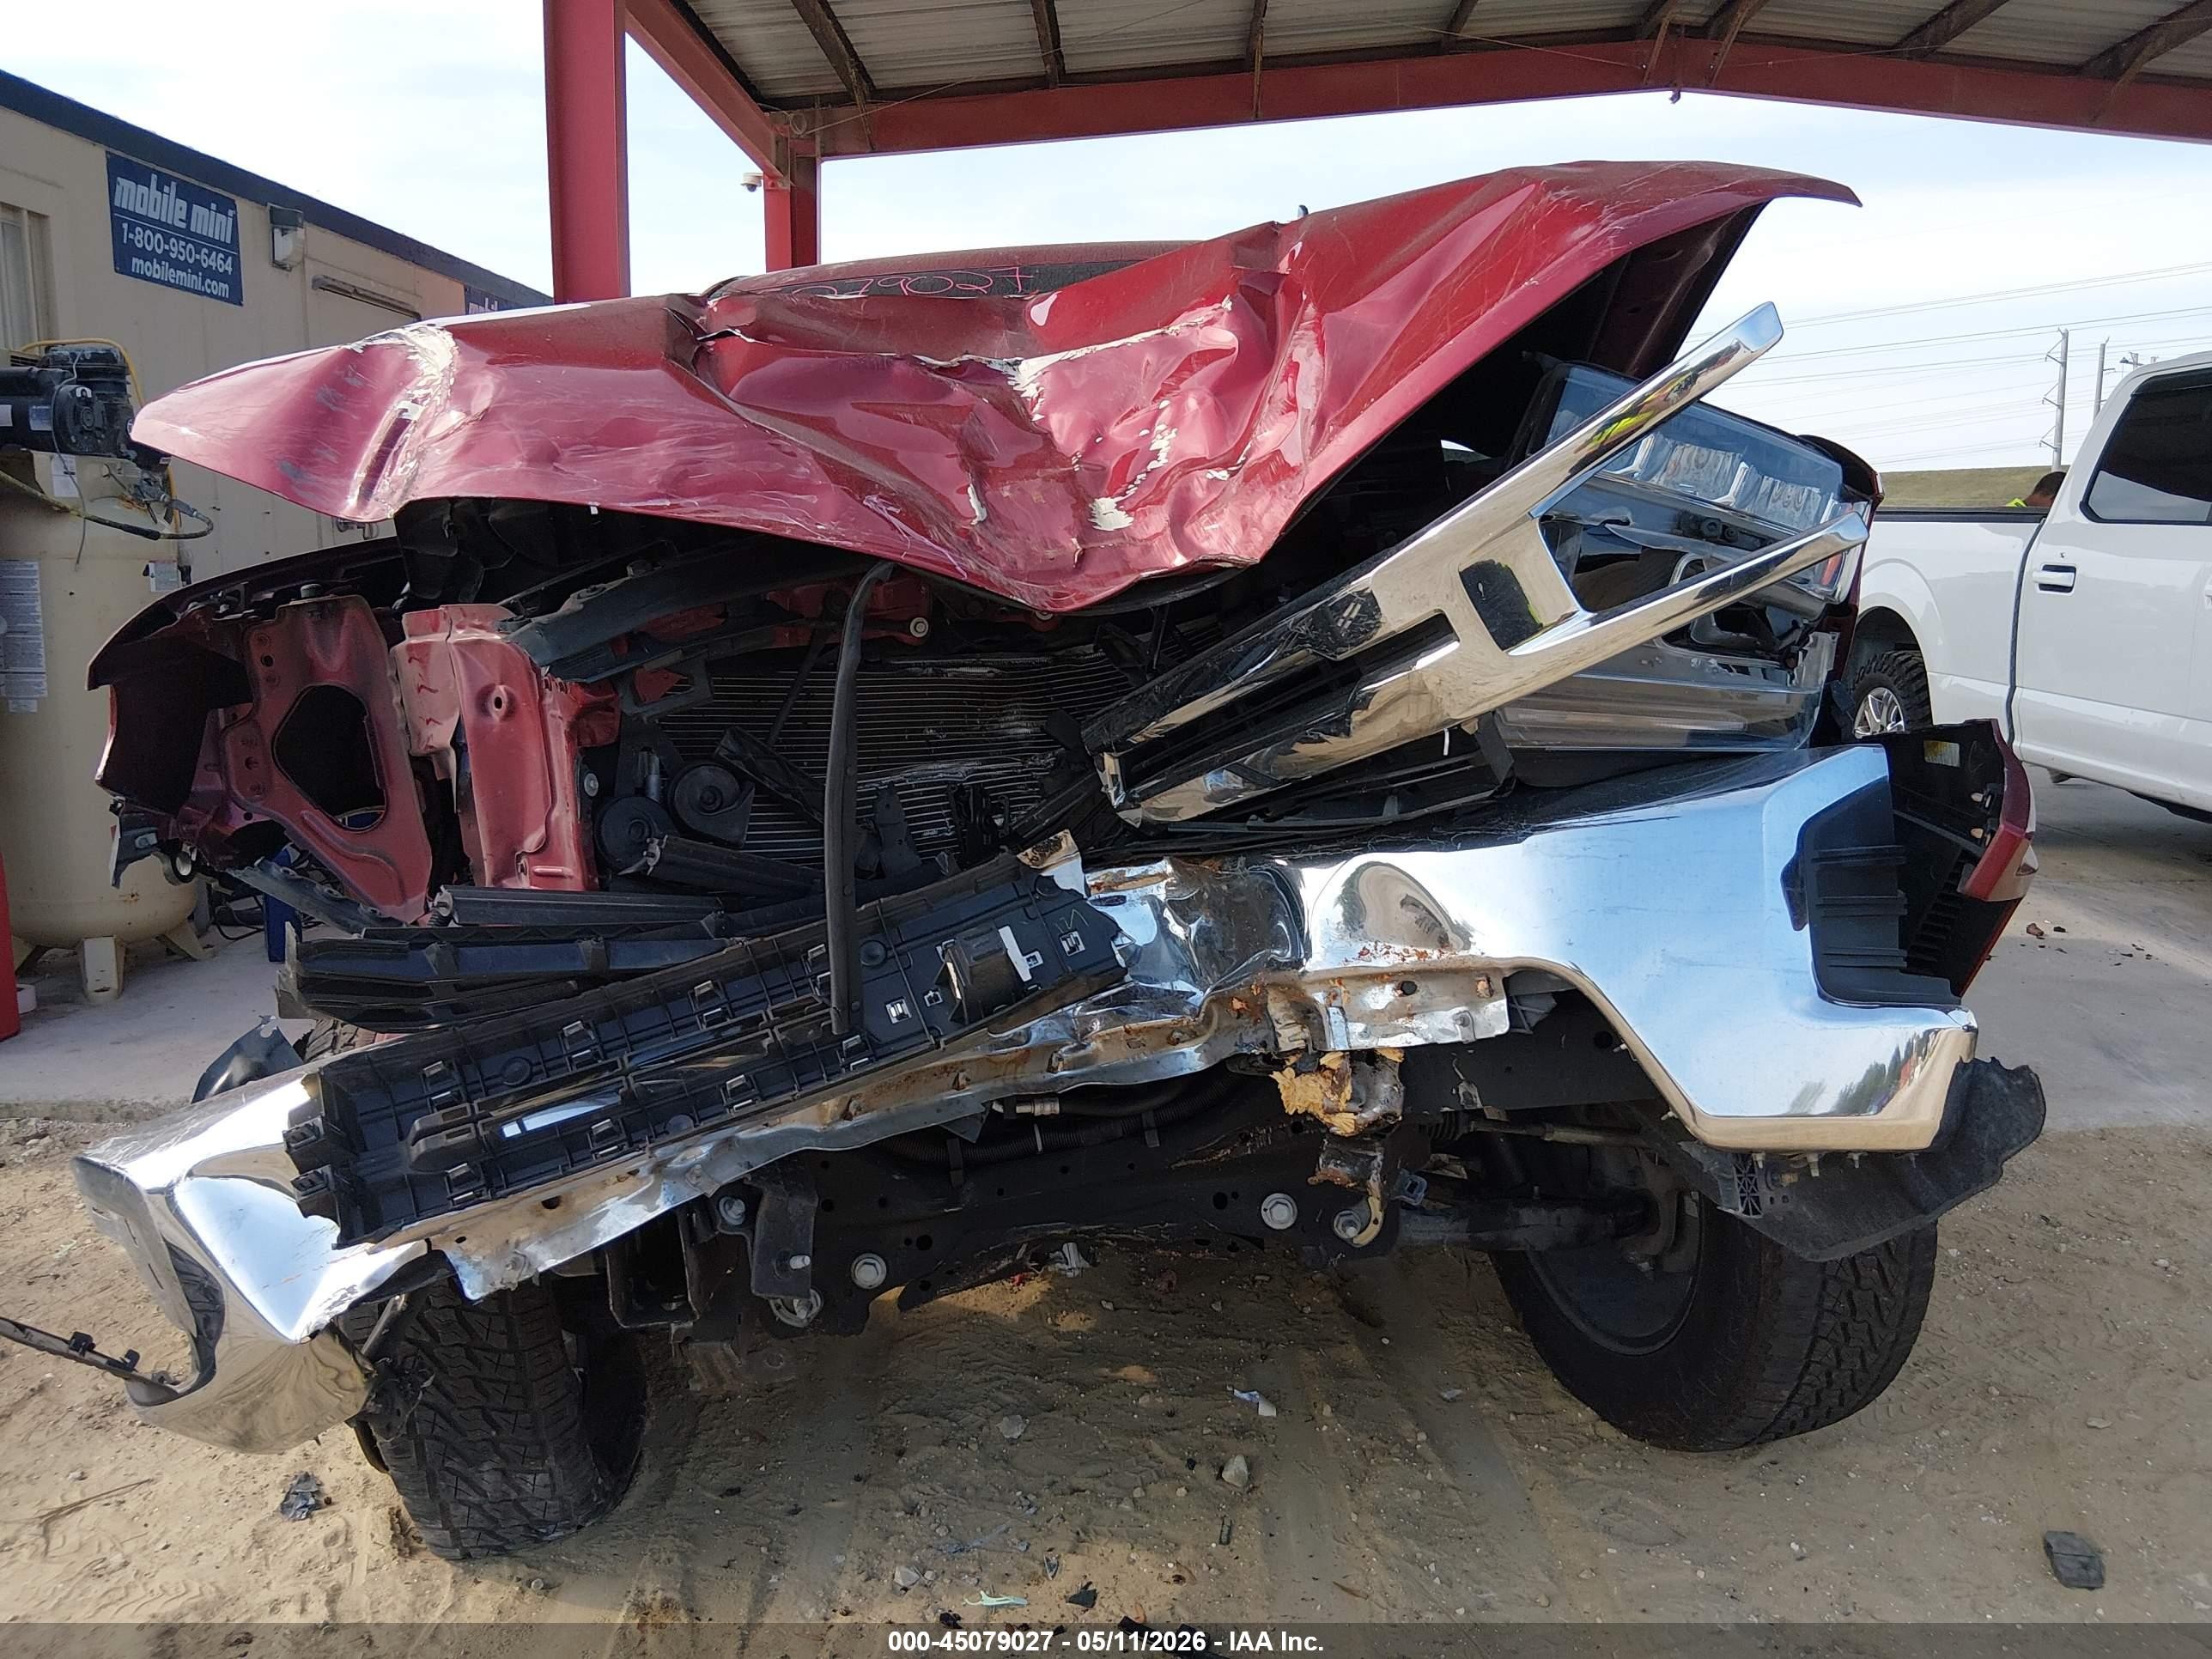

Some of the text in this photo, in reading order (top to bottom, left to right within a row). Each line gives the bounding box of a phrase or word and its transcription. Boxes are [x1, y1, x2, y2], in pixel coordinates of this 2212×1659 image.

[113, 173, 235, 244] mobile mini
[122, 222, 233, 276] 1-800-950-6464
[131, 257, 229, 299] mobilemini.com
